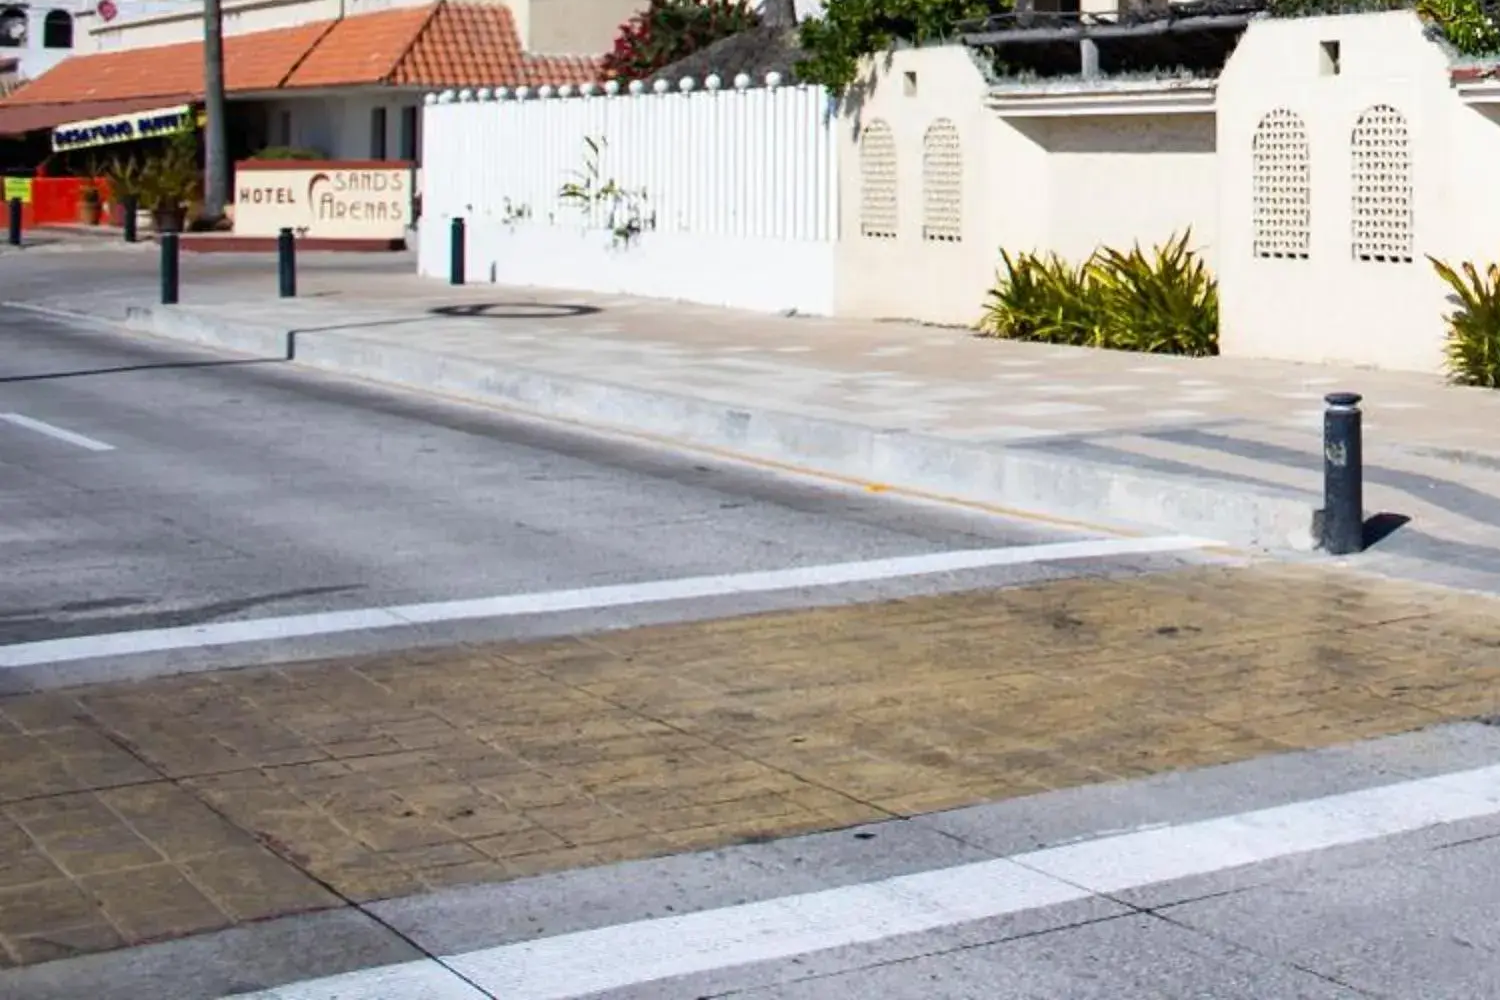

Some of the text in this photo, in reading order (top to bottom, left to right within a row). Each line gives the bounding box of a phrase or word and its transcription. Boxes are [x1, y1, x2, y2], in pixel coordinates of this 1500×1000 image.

[335, 172, 403, 191] SANDS
[239, 187, 296, 204] HOTEL
[320, 192, 403, 220] ARENAS
